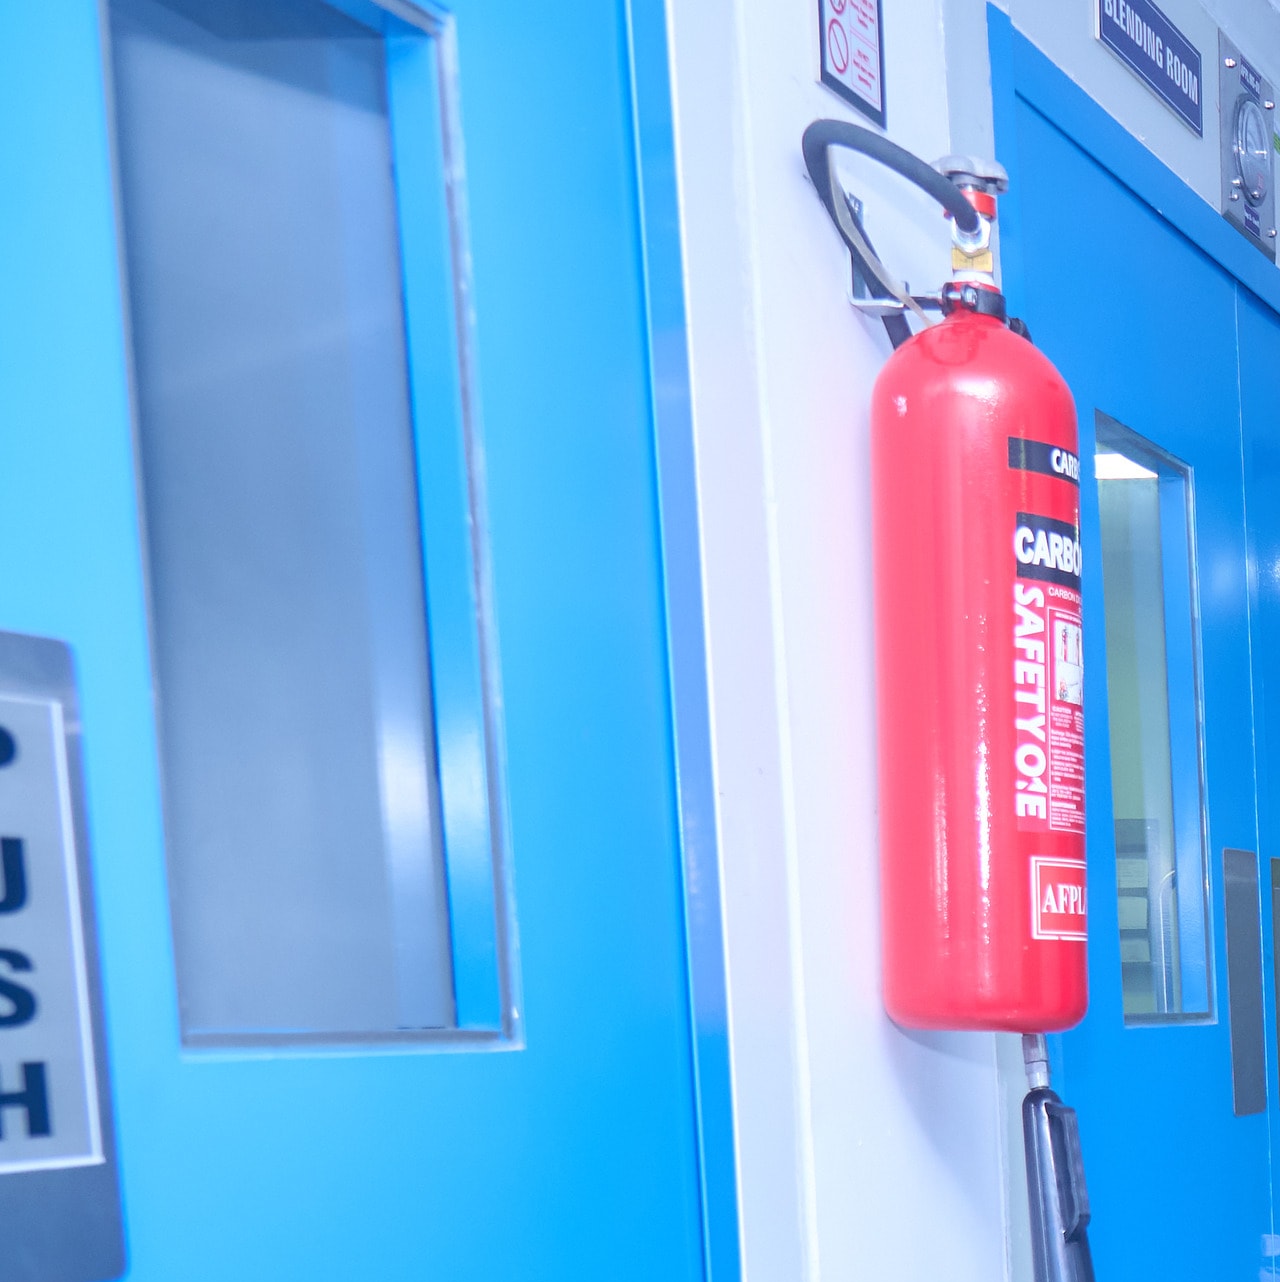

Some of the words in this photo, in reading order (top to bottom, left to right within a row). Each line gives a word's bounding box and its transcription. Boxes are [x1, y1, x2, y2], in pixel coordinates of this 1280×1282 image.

[1166, 46, 1198, 105] ROOM
[1052, 448, 1080, 482] CARB
[1042, 883, 1086, 915] AFPL
